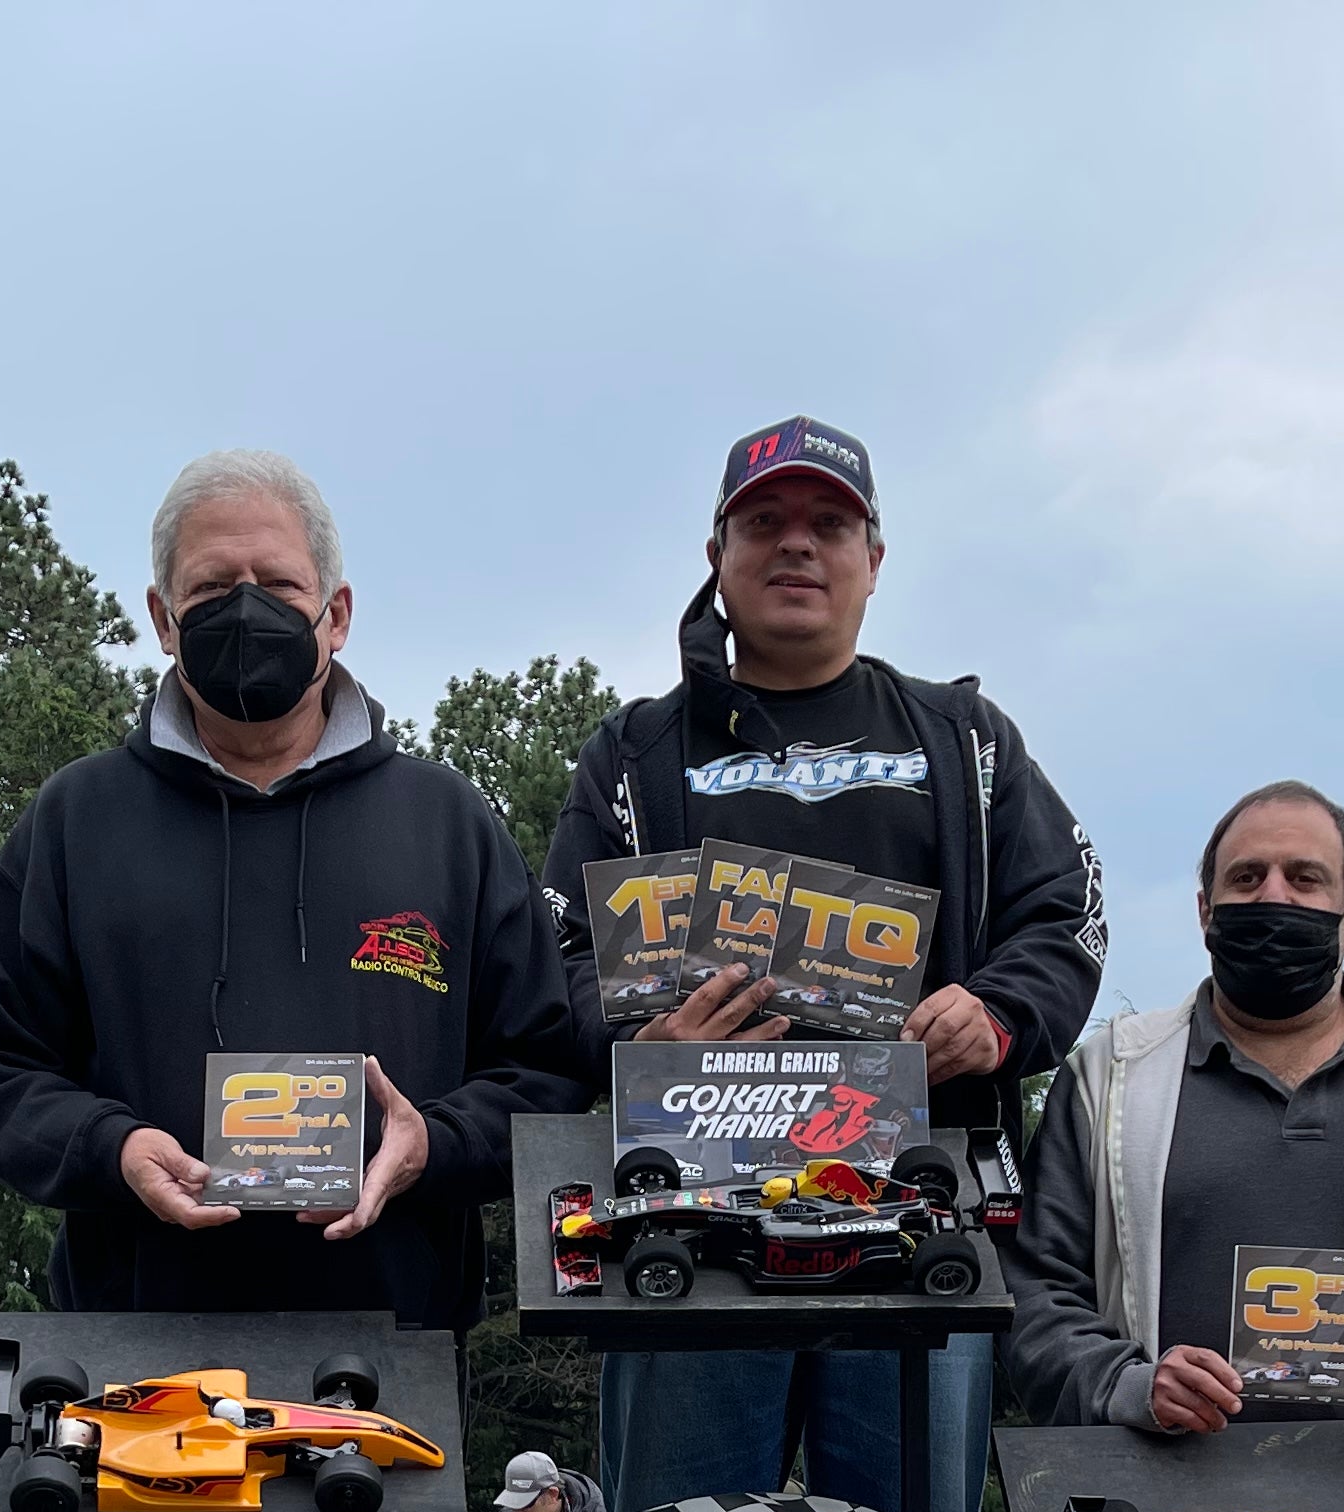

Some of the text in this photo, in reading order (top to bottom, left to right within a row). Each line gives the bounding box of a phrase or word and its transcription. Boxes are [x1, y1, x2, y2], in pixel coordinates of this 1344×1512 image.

[690, 755, 927, 792] VOLANTE
[789, 887, 921, 970] TQ
[350, 957, 383, 972] RADIO
[383, 961, 423, 984] CONTROL
[701, 1051, 840, 1074] CARRERA GRATIS
[661, 1084, 828, 1113] GOKART
[330, 1113, 352, 1128] A
[685, 1114, 796, 1139] MANIA
[708, 1214, 749, 1224] ORACLE
[820, 1221, 900, 1234] HONDA
